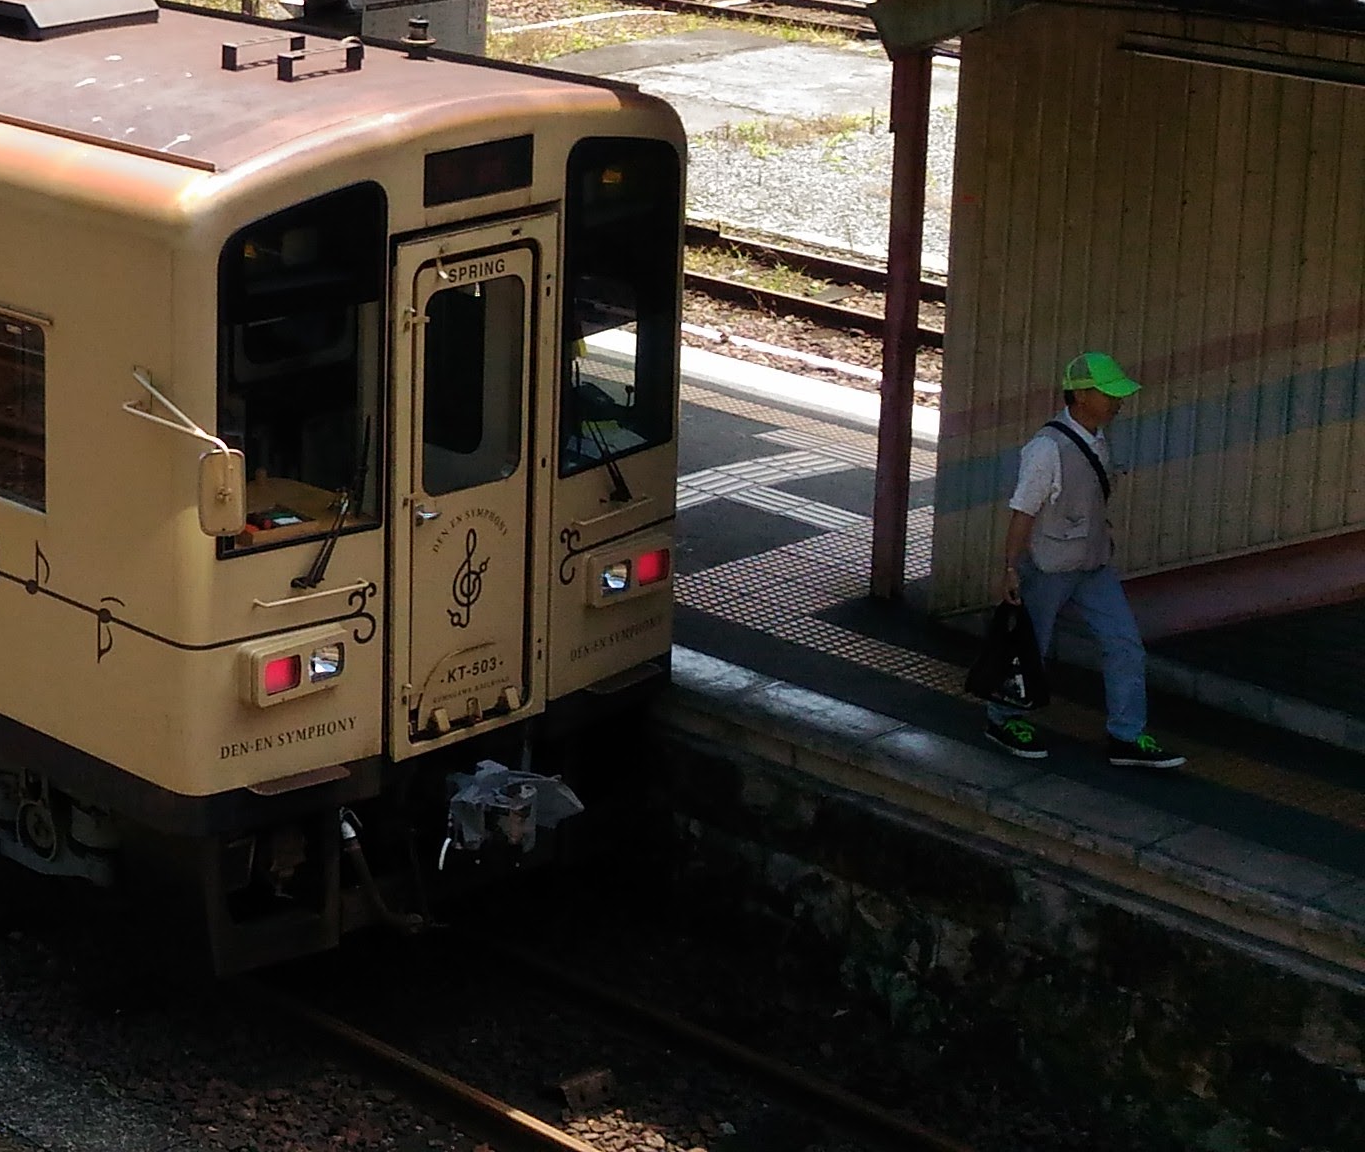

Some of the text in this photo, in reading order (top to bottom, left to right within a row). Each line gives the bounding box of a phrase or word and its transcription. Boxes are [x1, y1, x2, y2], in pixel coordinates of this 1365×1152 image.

[448, 259, 506, 283] SPRING
[219, 716, 358, 760] DEN-EN SYMPHONY
